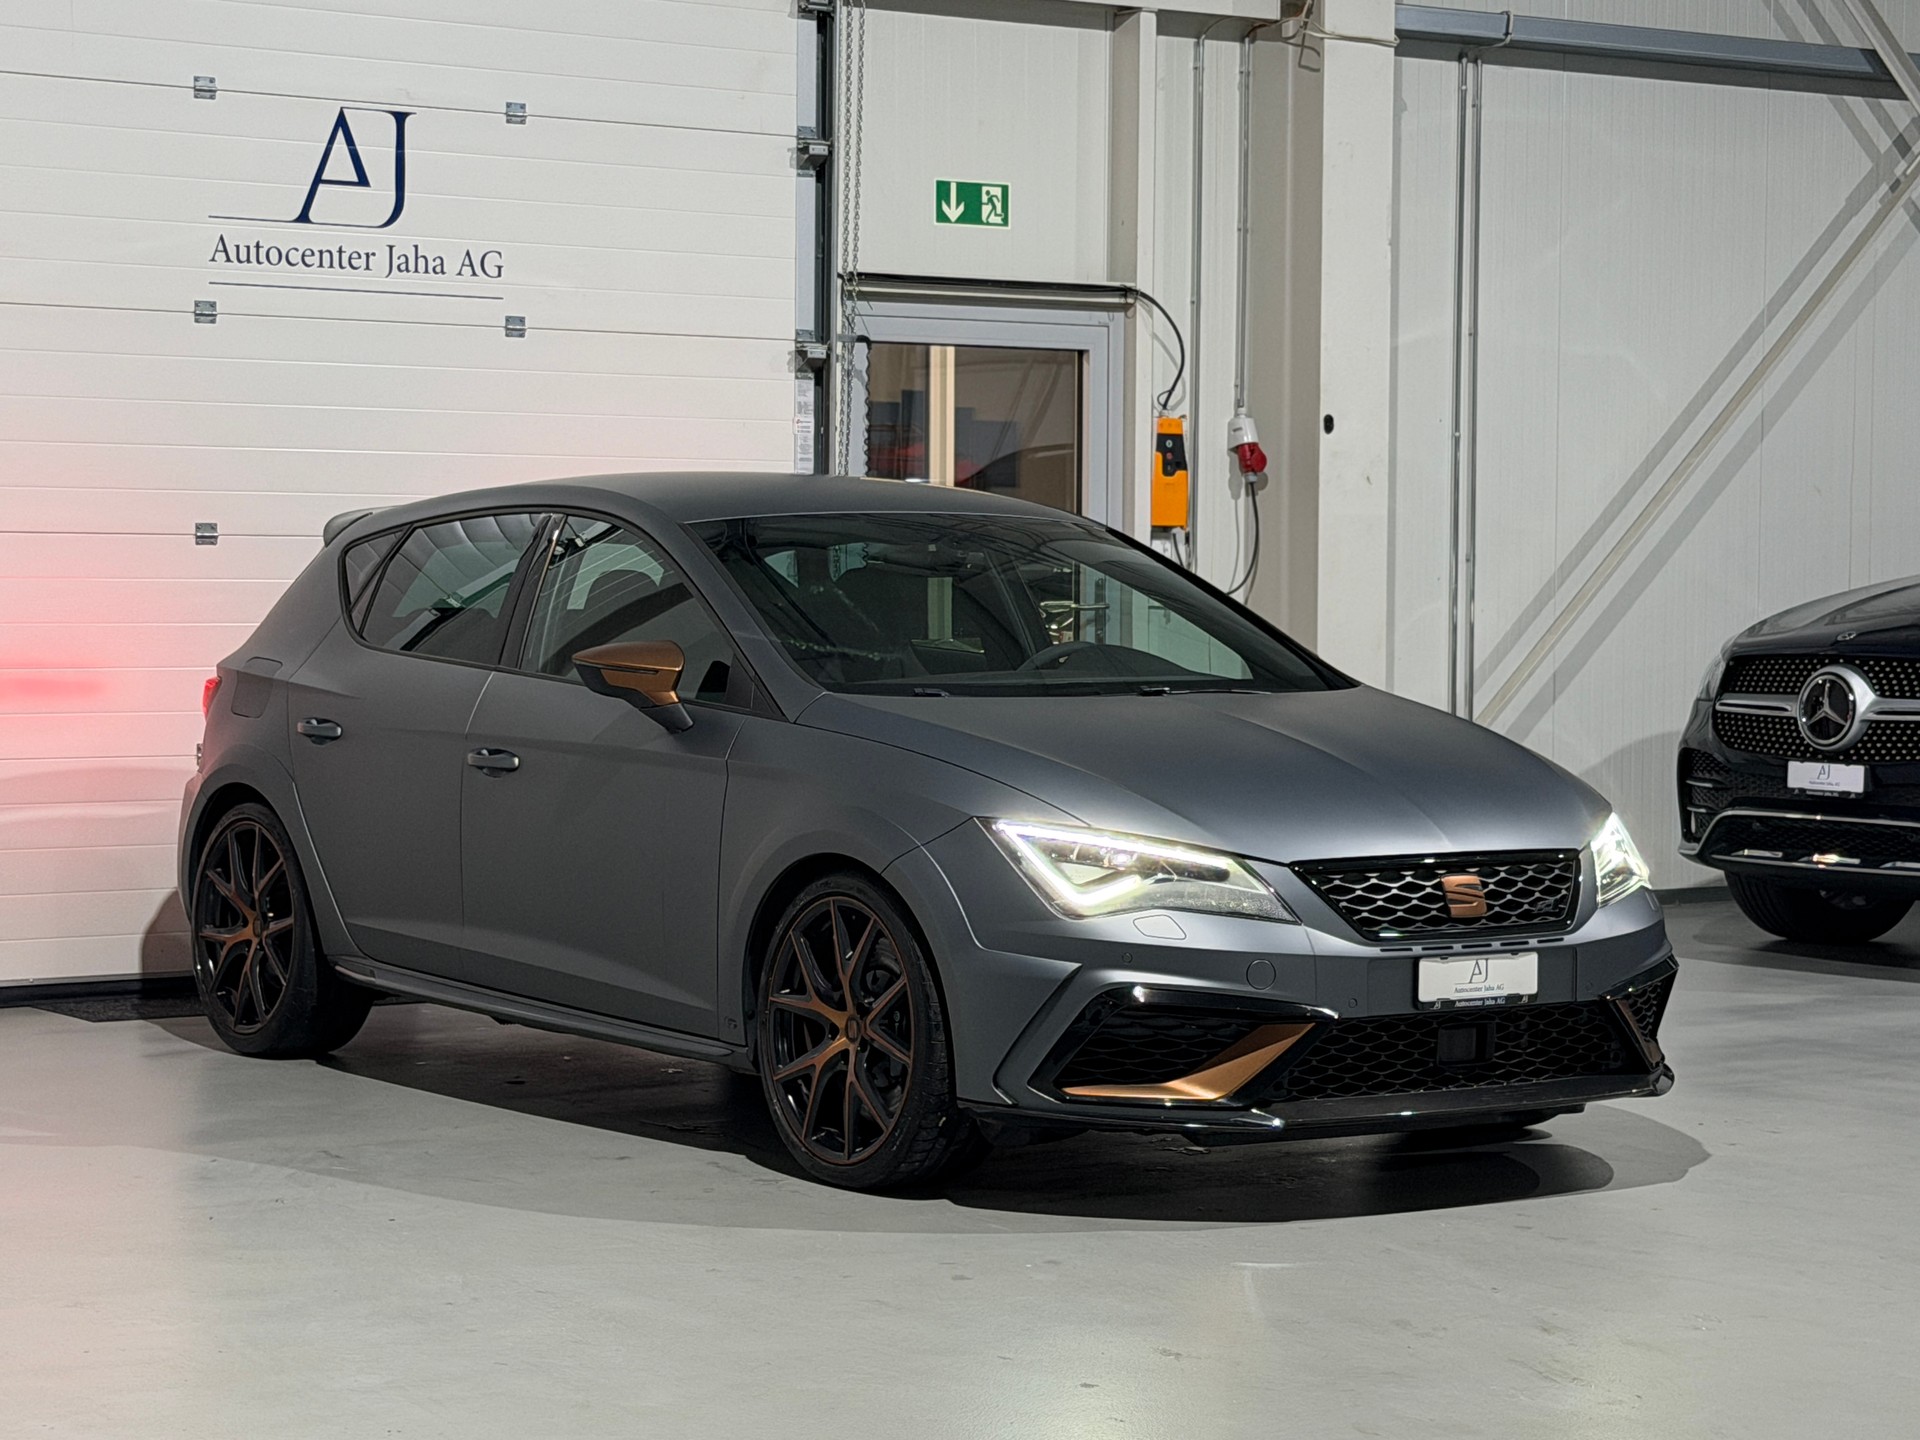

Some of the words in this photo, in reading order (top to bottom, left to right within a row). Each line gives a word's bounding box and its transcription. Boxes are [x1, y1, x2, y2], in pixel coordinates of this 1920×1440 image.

[290, 106, 418, 228] AJ
[208, 233, 377, 272] Autocenter
[385, 243, 447, 279] Jaha
[454, 248, 505, 279] AG
[1817, 764, 1831, 780] AJ
[1468, 958, 1489, 984] AJ
[1454, 985, 1483, 993] Autocenter
[1484, 984, 1495, 993] Jaha
[1496, 983, 1505, 991] AG
[1455, 999, 1483, 1007] Autocenter
[1484, 998, 1496, 1006] Jaha
